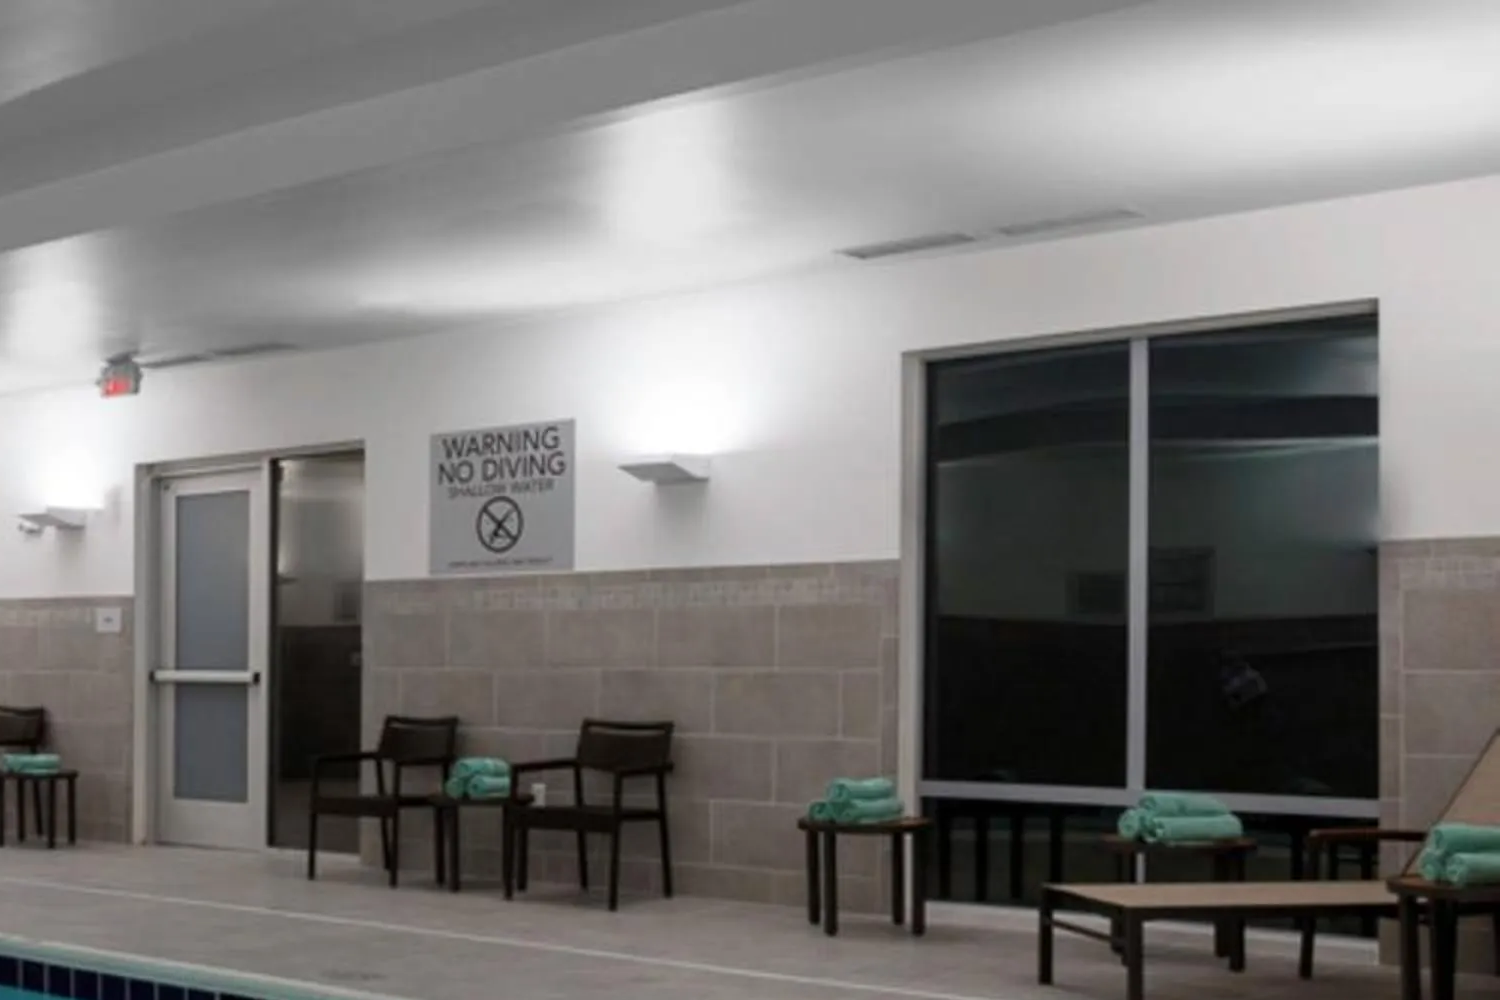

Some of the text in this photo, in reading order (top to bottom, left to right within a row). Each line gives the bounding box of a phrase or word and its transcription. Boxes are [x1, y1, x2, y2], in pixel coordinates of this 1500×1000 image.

[442, 426, 560, 459] WARNING
[438, 451, 566, 485] NO DIVING
